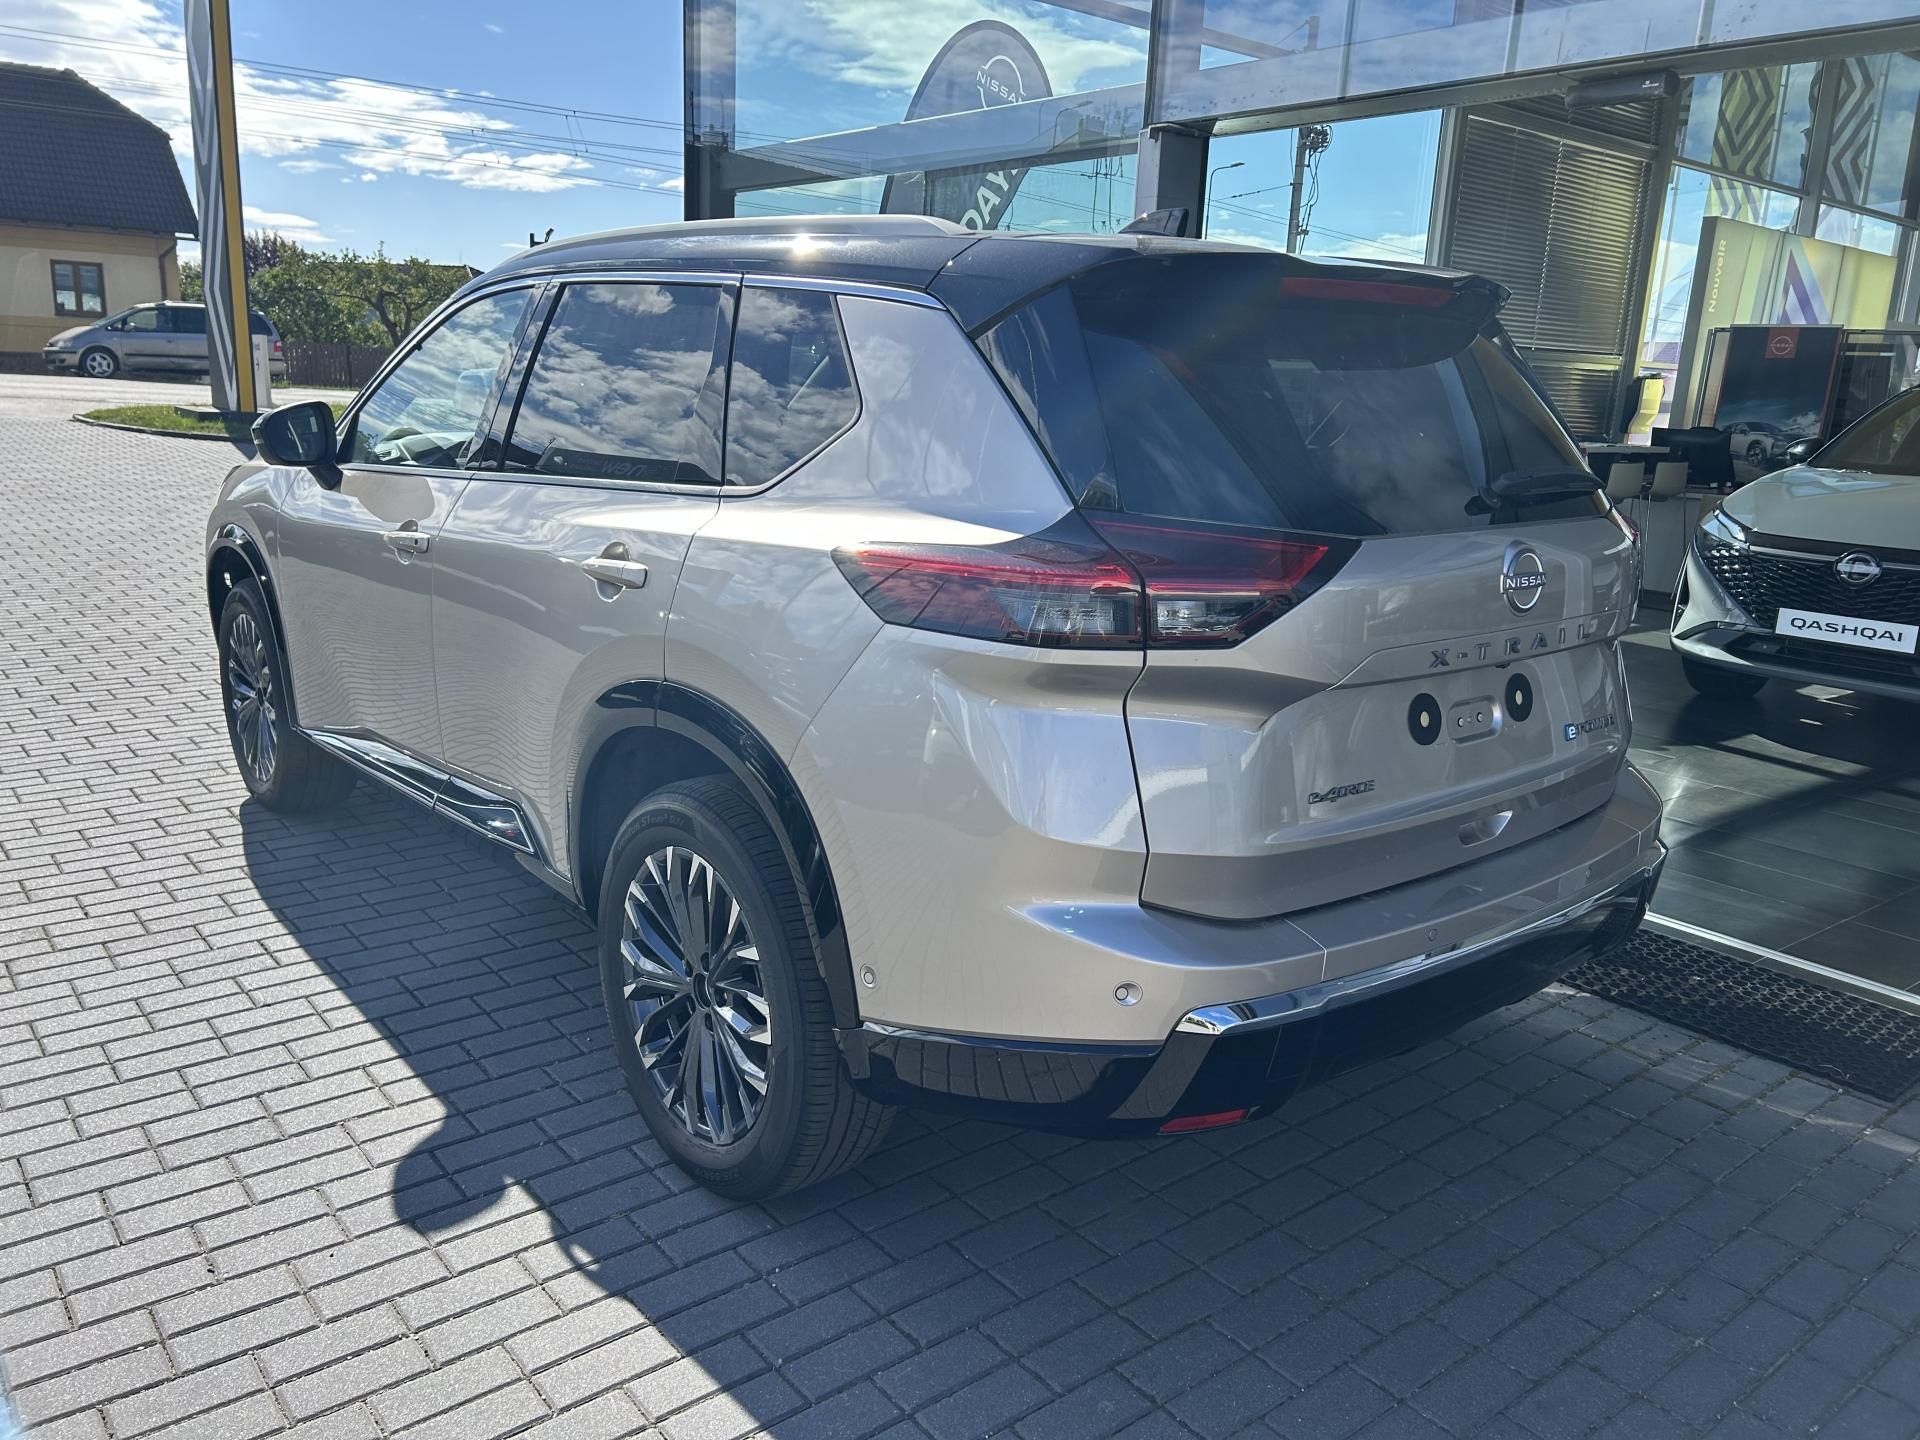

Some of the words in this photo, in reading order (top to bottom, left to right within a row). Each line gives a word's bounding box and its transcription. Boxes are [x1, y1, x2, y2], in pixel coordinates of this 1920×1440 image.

[959, 168, 1018, 232] DAY
[1506, 575, 1547, 588] NISSAN
[1429, 623, 1591, 669] X-TRAIL
[1790, 617, 1903, 642] QASHQAI
